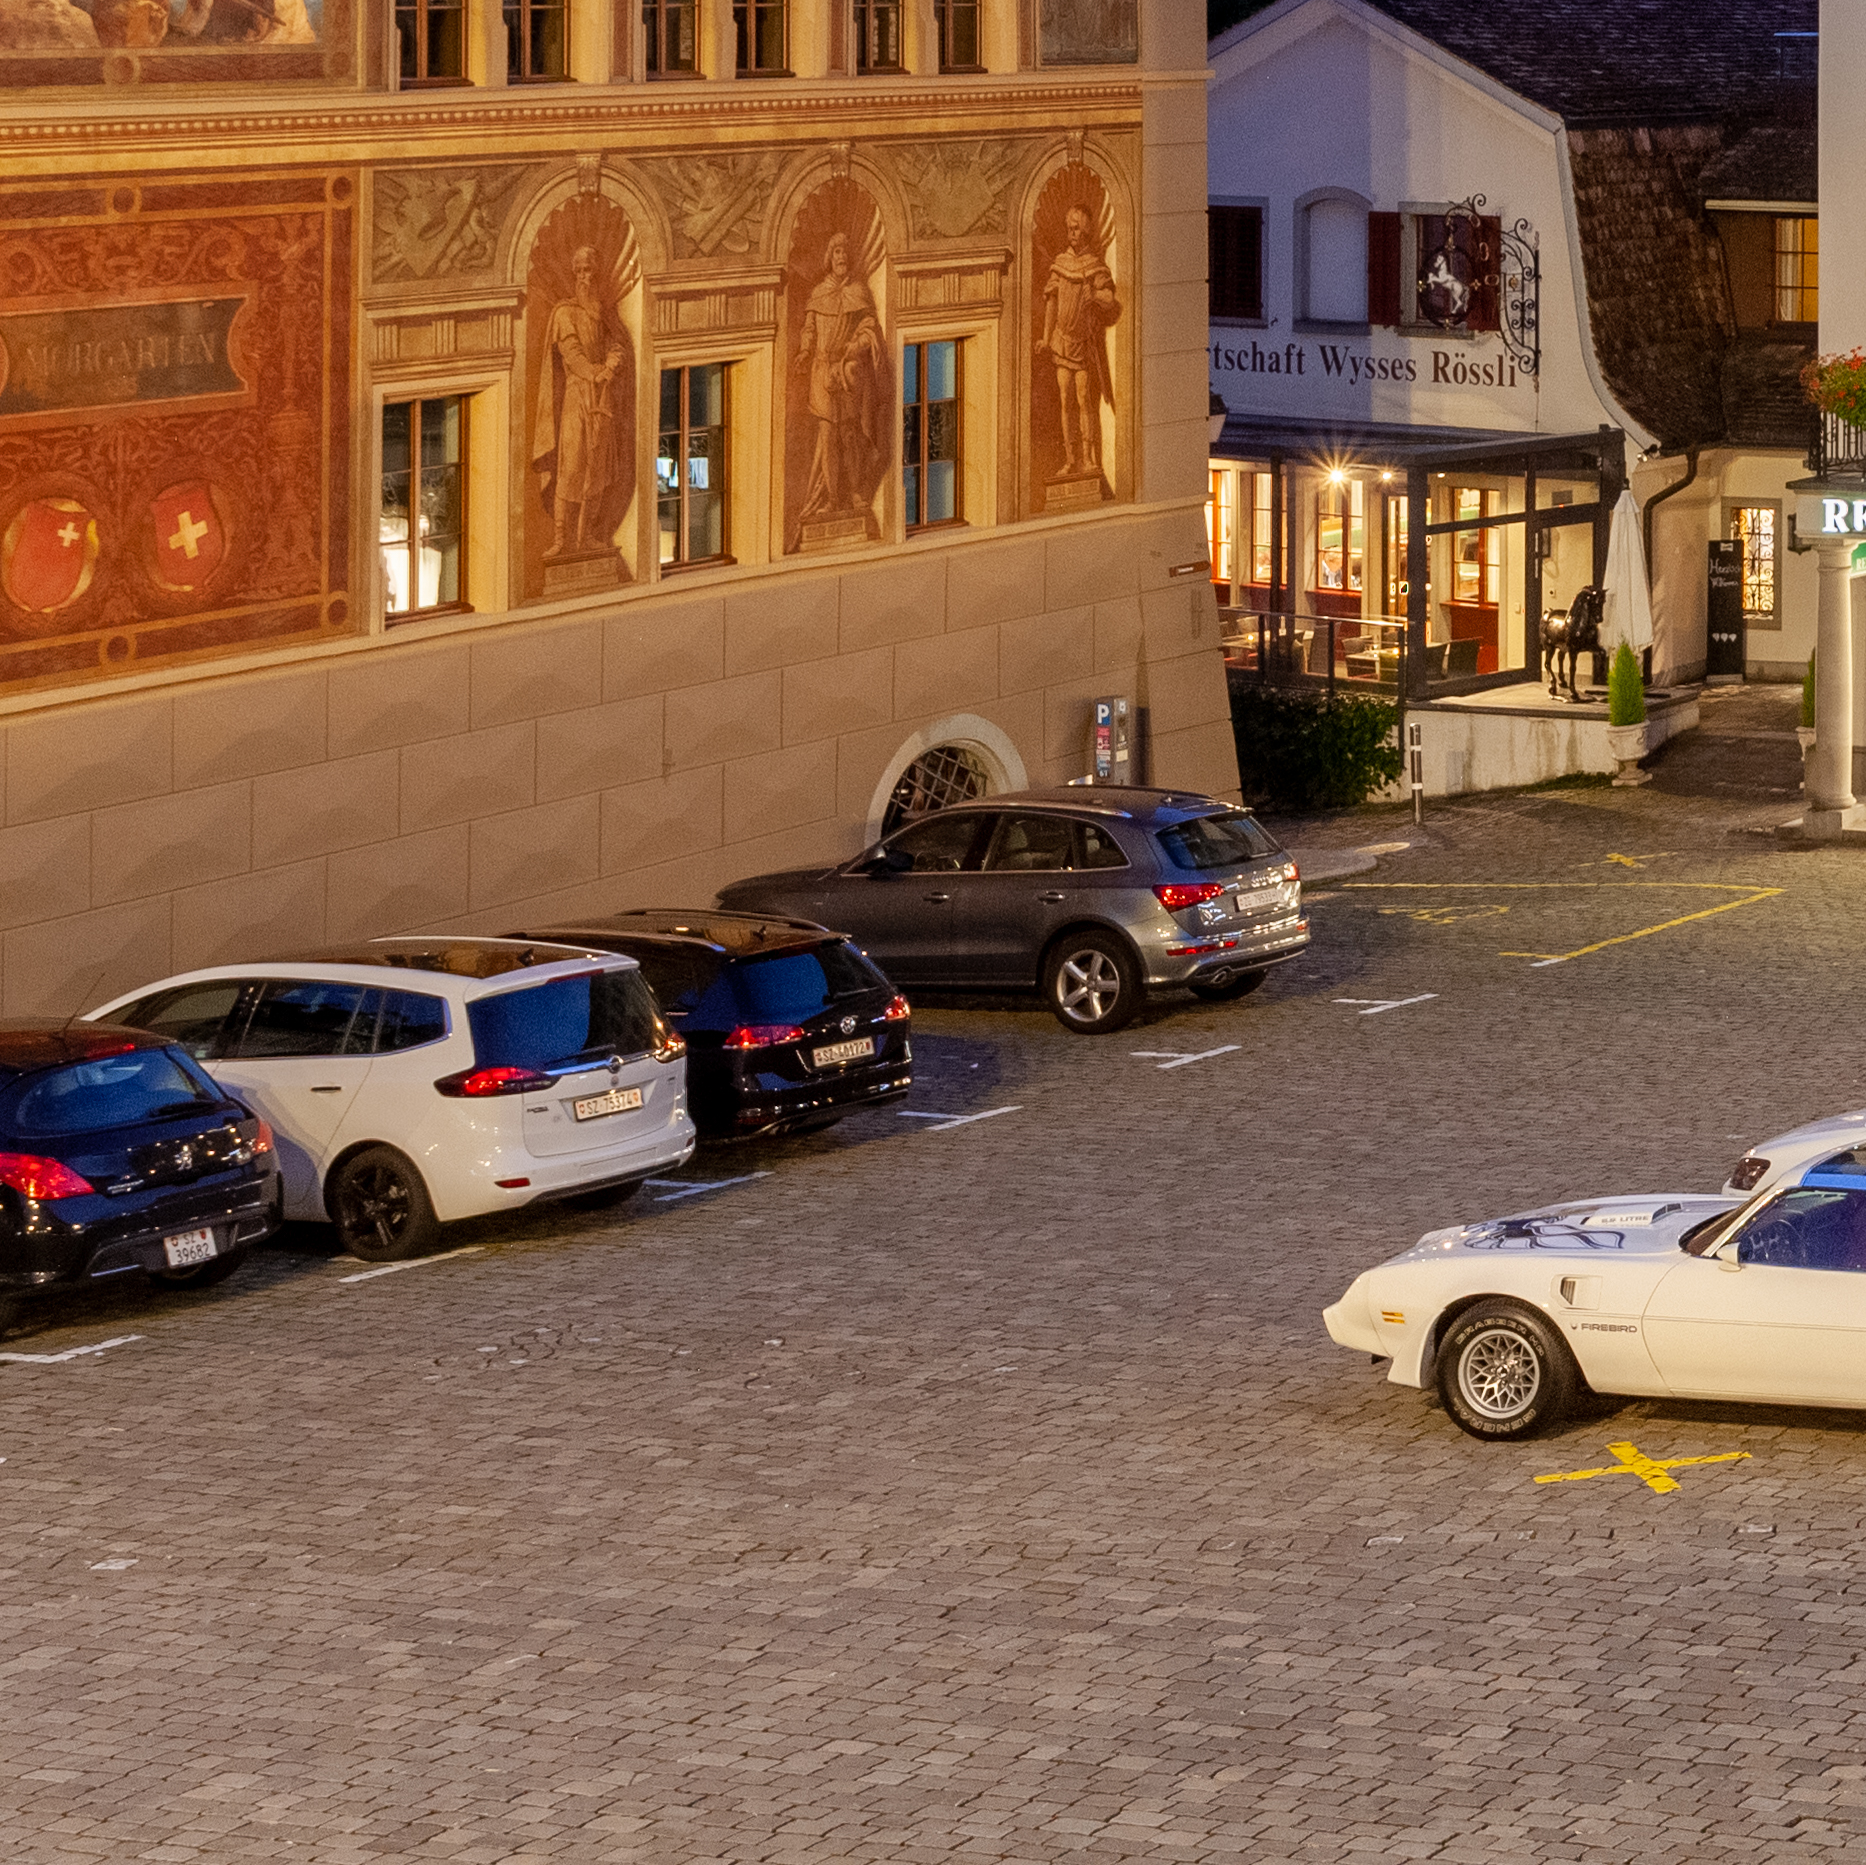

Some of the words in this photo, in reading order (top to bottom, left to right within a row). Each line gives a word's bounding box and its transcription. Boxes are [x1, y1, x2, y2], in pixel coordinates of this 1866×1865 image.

[1318, 344, 1418, 385] Wysses
[1431, 350, 1518, 387] Rössli
[1097, 703, 1110, 724] P
[183, 1232, 196, 1245] SZ
[175, 1242, 211, 1264] 39682
[1581, 1323, 1638, 1333] FIREBIRD
